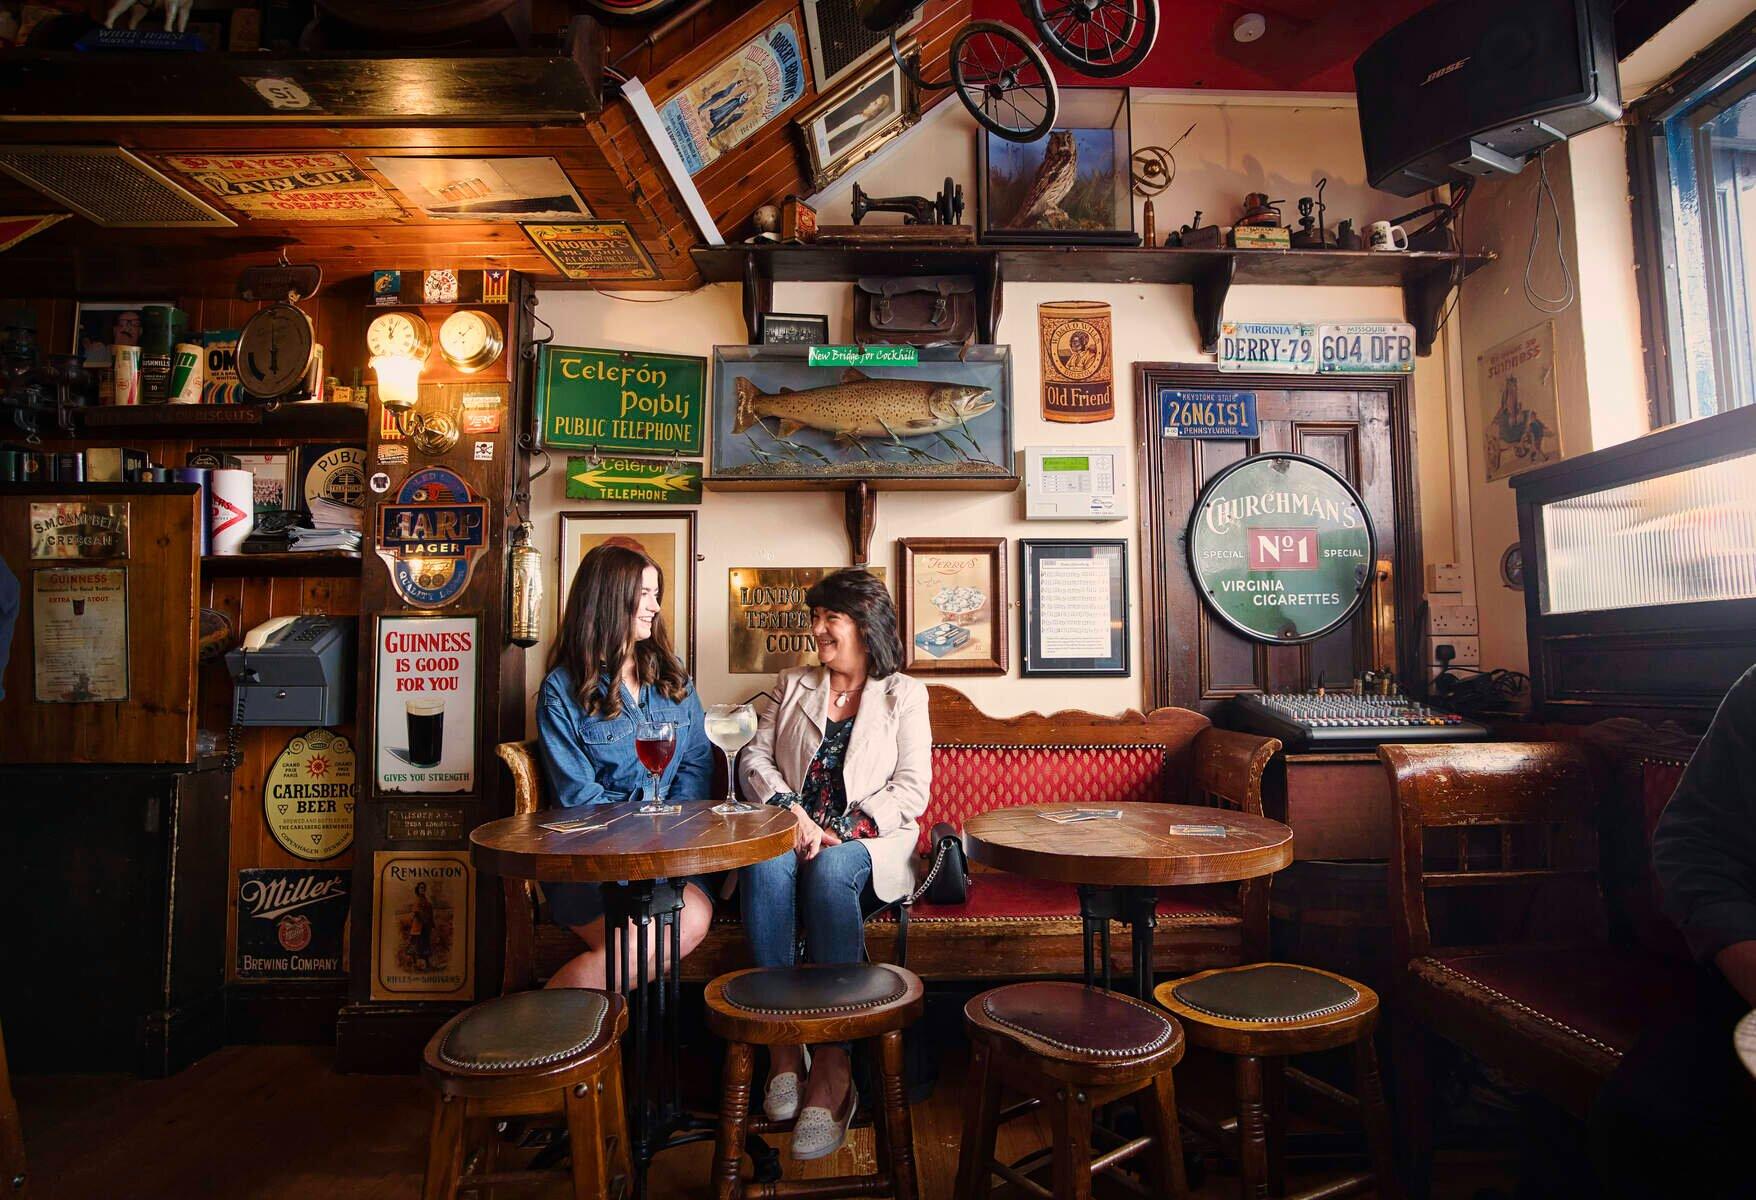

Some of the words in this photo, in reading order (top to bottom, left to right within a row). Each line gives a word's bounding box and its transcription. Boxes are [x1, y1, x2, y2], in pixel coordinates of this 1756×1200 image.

[1422, 58, 1468, 84] BOSE
[1244, 325, 1291, 335] VIRGINIA
[1347, 326, 1386, 334] MISSOURI
[811, 349, 831, 360] New
[832, 349, 860, 366] Bridge
[876, 348, 915, 361] Cockhill
[1224, 339, 1313, 363] DERRY-79
[1322, 336, 1362, 362] 604
[1371, 336, 1411, 362] DFB
[208, 350, 236, 371] OM
[554, 416, 606, 437] PUBLIC
[611, 419, 692, 442] TELEPHONE
[317, 451, 360, 473] PUBL
[600, 488, 668, 500] TELEPHONE
[1206, 490, 1356, 535] CHURCHMAN'S
[389, 511, 480, 540] HARP
[405, 544, 460, 553] LAGER
[1203, 551, 1245, 559] SPECIAL
[1323, 549, 1363, 558] SPECIAL
[50, 574, 108, 585] GUINNESS
[1221, 580, 1285, 592] VIRGINIA
[740, 586, 806, 606] LONDO
[1253, 593, 1340, 606] CIGARETTES
[745, 610, 811, 629] TEMPE
[385, 631, 472, 653] GUINNESS
[766, 634, 817, 653] COUN
[396, 659, 410, 672] IS
[416, 658, 459, 671] GOOD
[396, 678, 424, 691] FOR
[428, 677, 459, 690] YOU
[384, 774, 407, 782] GIVES
[429, 773, 470, 781] STRENGTH
[297, 800, 337, 813] BEER
[281, 832, 319, 854] COPENHAGEN
[391, 866, 461, 880] REMINGTON
[241, 876, 343, 915] Miller
